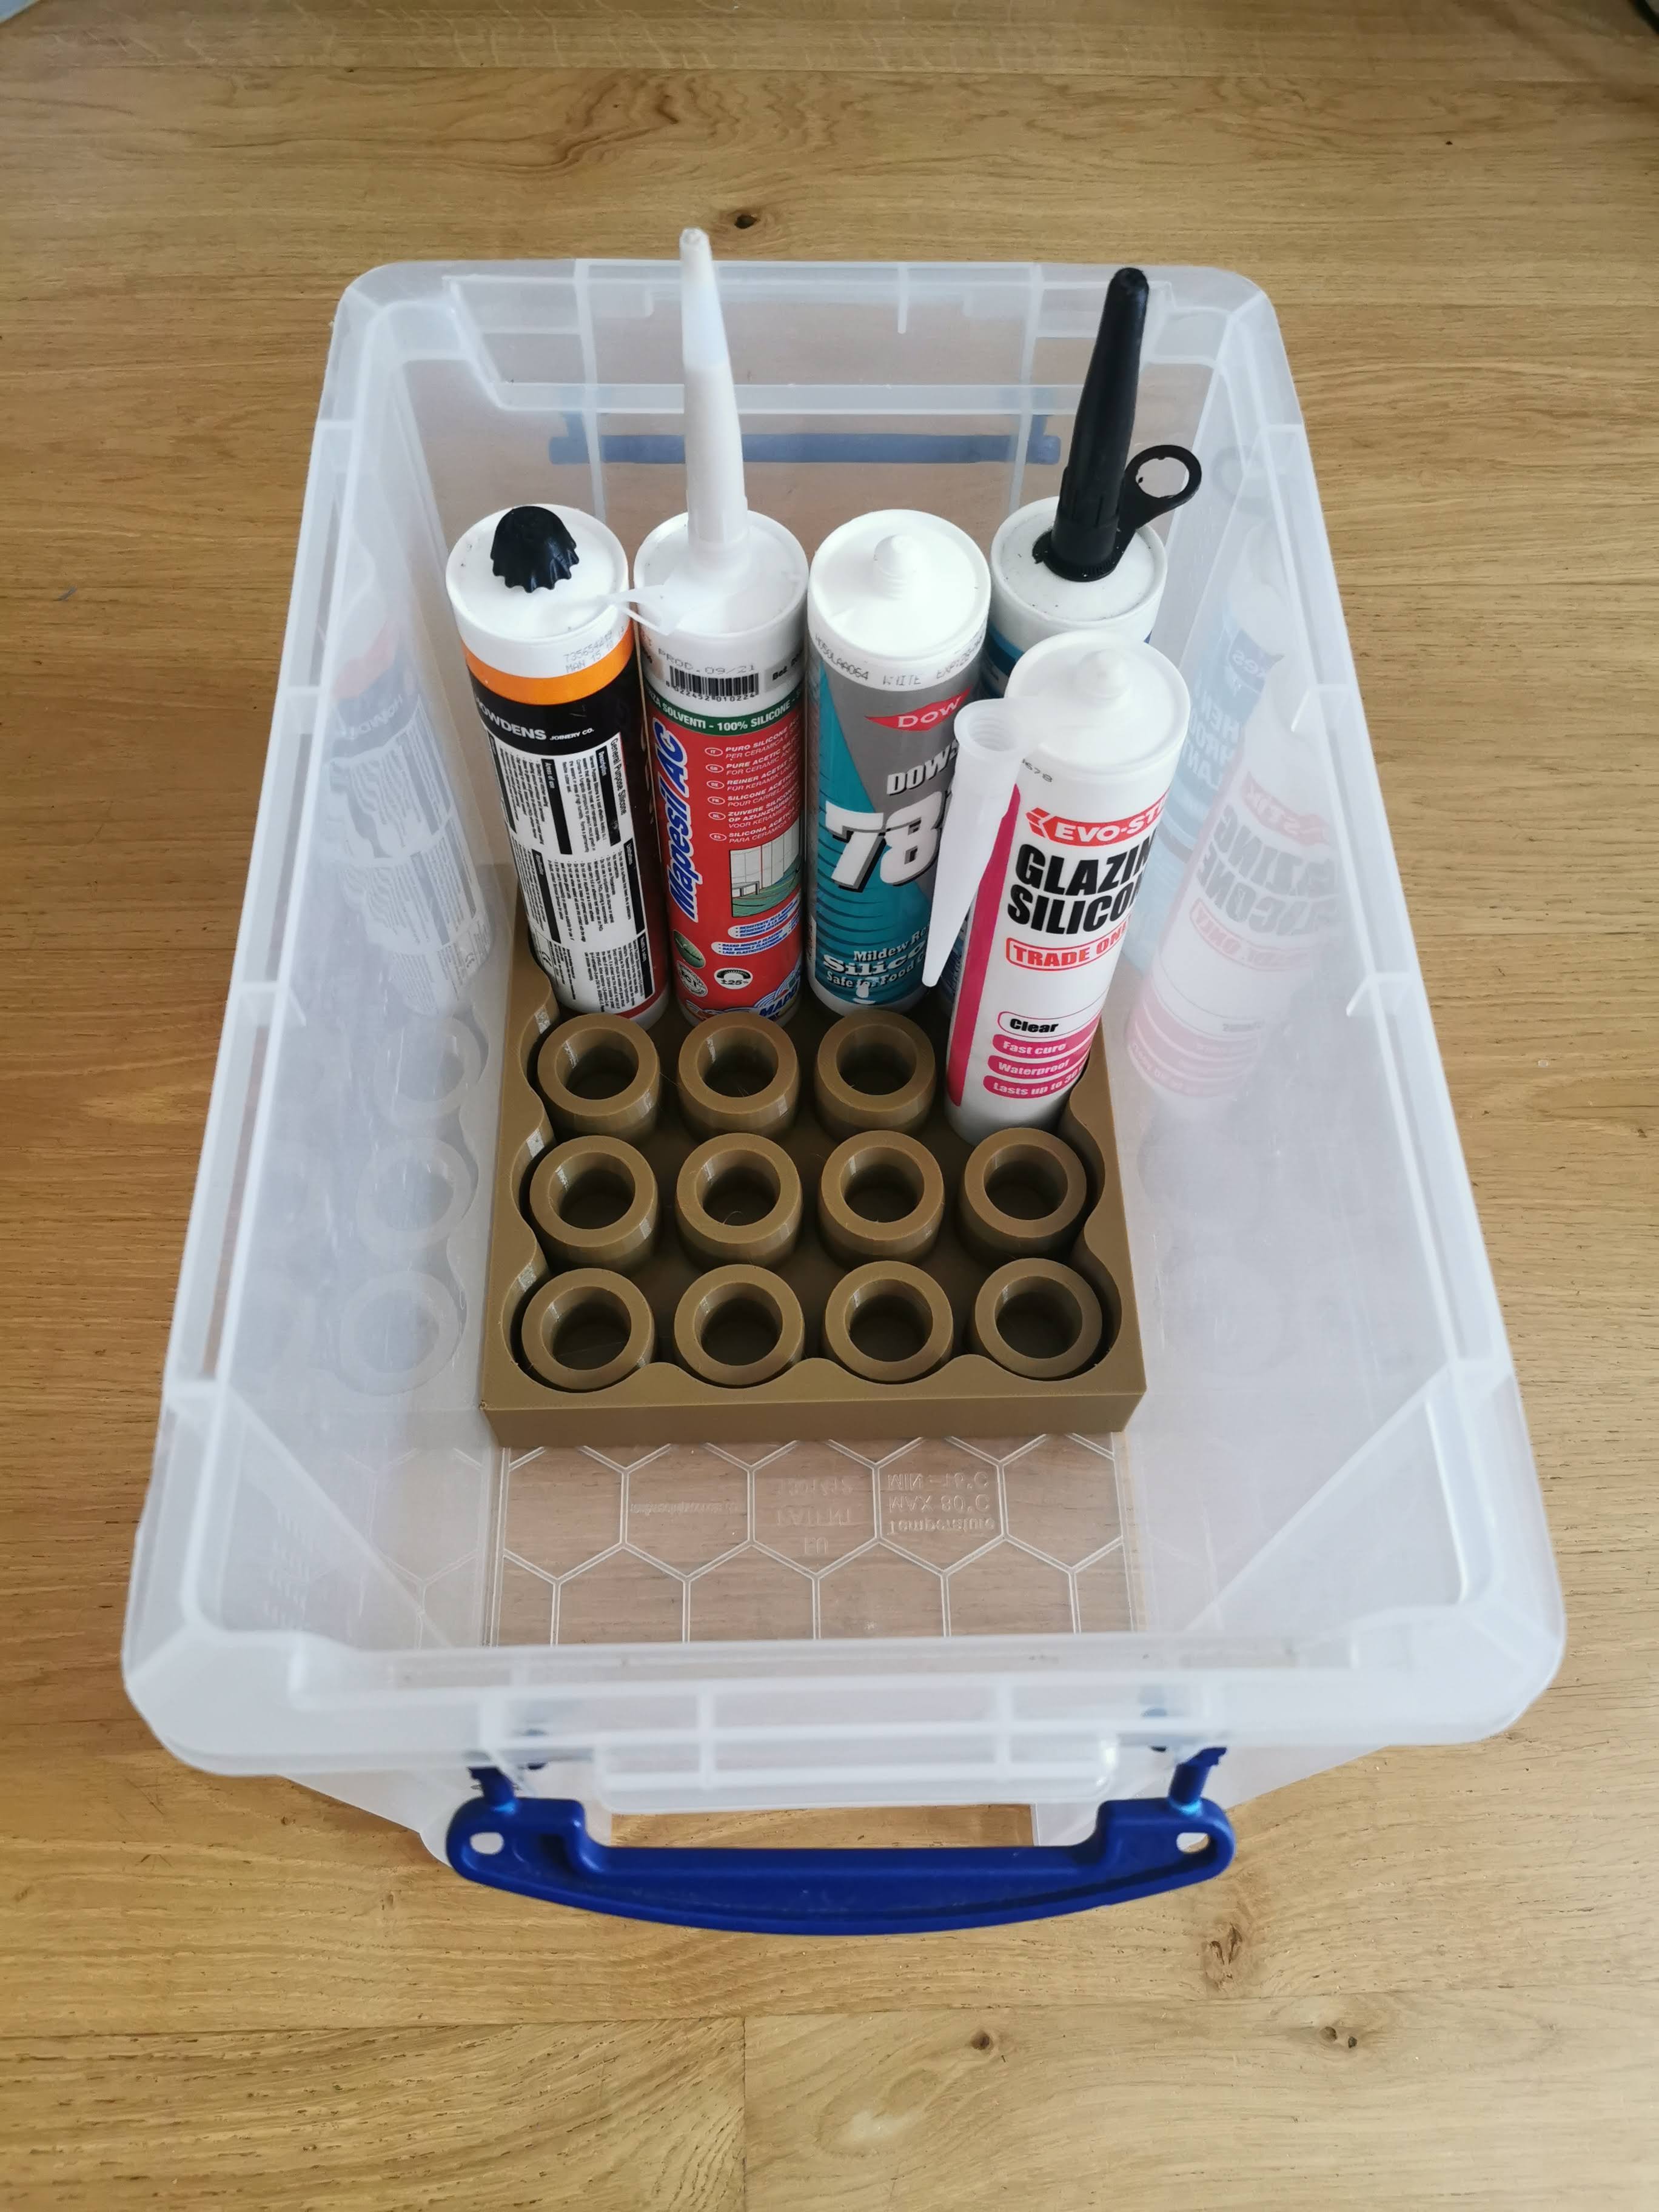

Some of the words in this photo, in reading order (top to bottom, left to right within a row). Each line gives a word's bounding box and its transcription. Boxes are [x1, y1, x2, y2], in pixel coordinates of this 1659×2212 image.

[663, 702, 706, 729] SOLVENTI
[717, 720, 748, 731] 100%
[751, 699, 791, 728] SILICONE
[898, 695, 960, 728] DOW
[549, 731, 581, 741] JOINERY
[581, 728, 595, 736] CO.
[610, 738, 621, 765] General
[653, 718, 688, 797] AC
[614, 763, 625, 791] Purpose
[727, 776, 759, 785] REINER
[618, 789, 628, 816] Silicone
[728, 789, 766, 801] SILICONE
[728, 806, 764, 817] ZUIVERE
[1055, 794, 1165, 842] EVO-STI
[729, 826, 767, 837] SILICONA
[825, 791, 950, 890] 78
[659, 772, 702, 922] Mapesil
[1016, 826, 1157, 896] GLAZIN
[823, 940, 926, 976] Silico
[854, 940, 910, 961] Mildew
[1013, 945, 1090, 967] TRADE
[827, 971, 854, 987] Safe
[880, 960, 914, 985] Food
[1010, 1018, 1059, 1033] Clear
[1003, 1041, 1033, 1054] Fast
[1034, 1043, 1067, 1054] cure
[998, 1058, 1070, 1076] Waterproof
[993, 1082, 1029, 1095] Lasts
[1031, 1085, 1049, 1095] up
[1051, 1081, 1063, 1091] to
